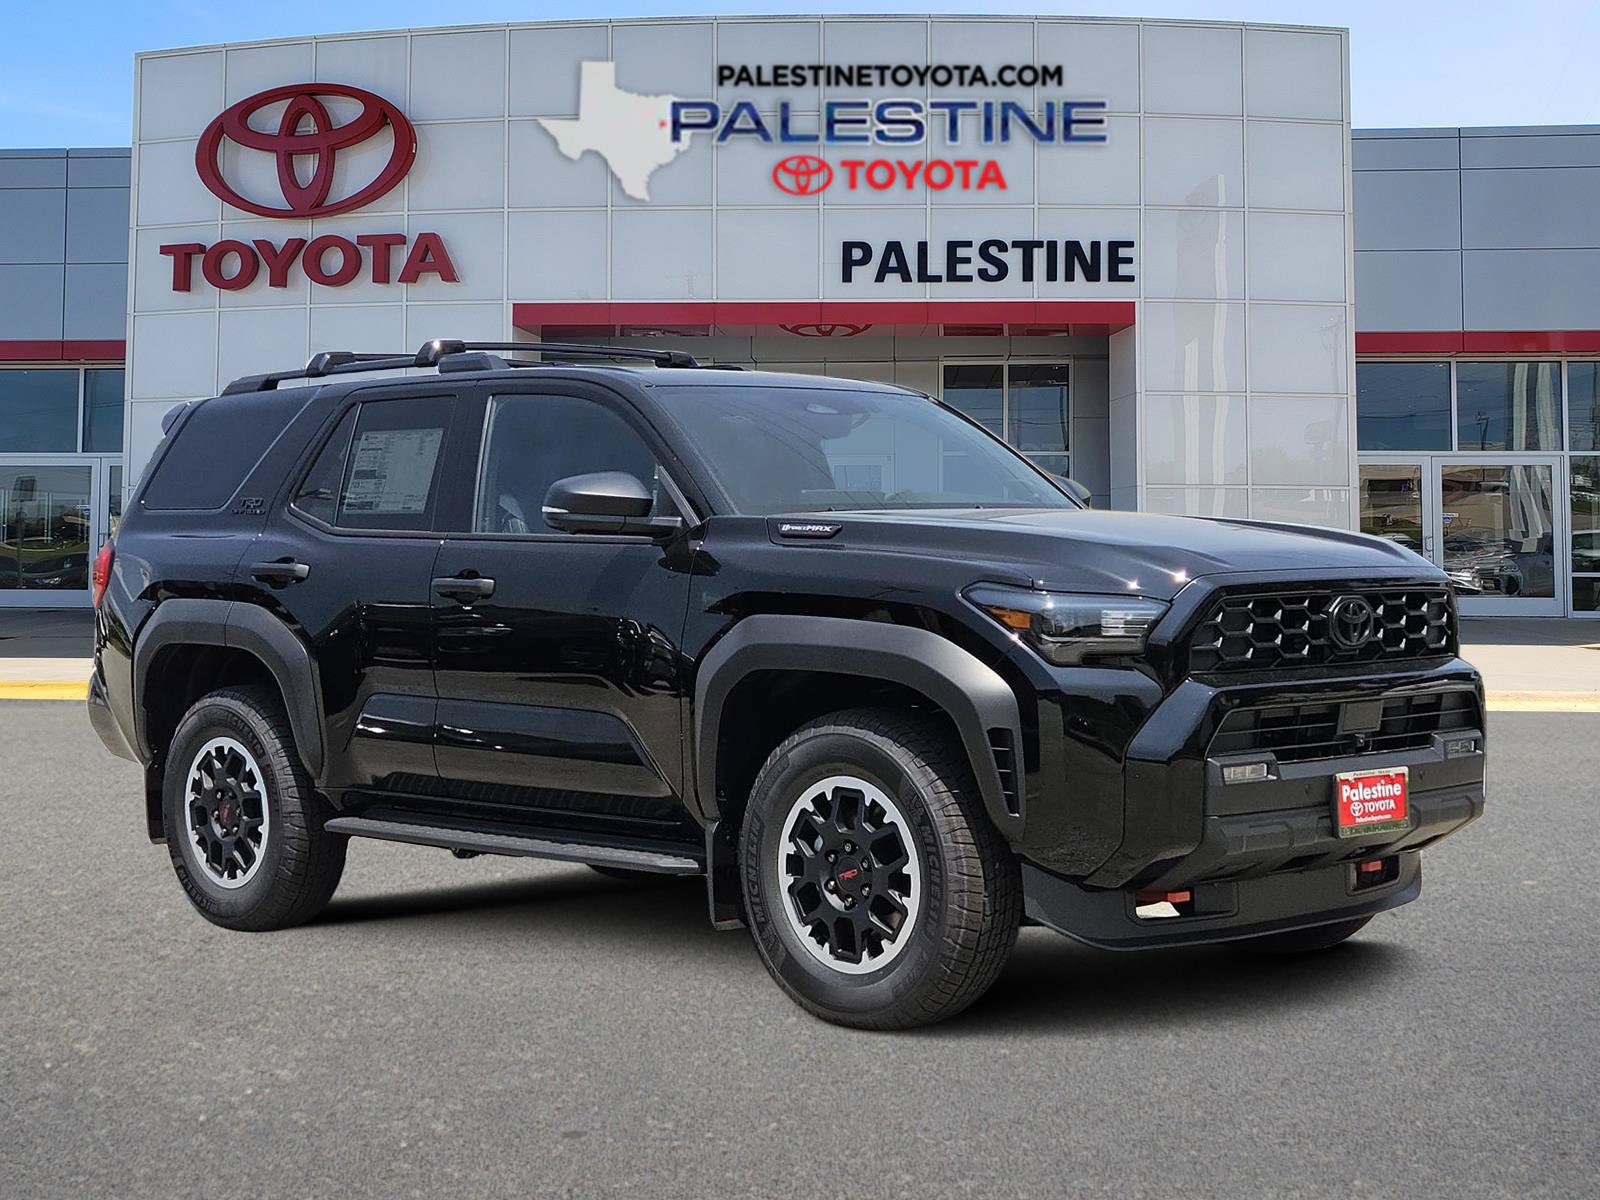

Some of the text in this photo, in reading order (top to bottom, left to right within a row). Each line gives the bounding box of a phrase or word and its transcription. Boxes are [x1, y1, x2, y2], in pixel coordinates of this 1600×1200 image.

[159, 231, 461, 293] TOYOTA
[842, 239, 1136, 284] PALESTINE
[1342, 780, 1401, 802] Palestine
[1364, 799, 1396, 813] TOYOTA
[838, 869, 858, 881] TRD
